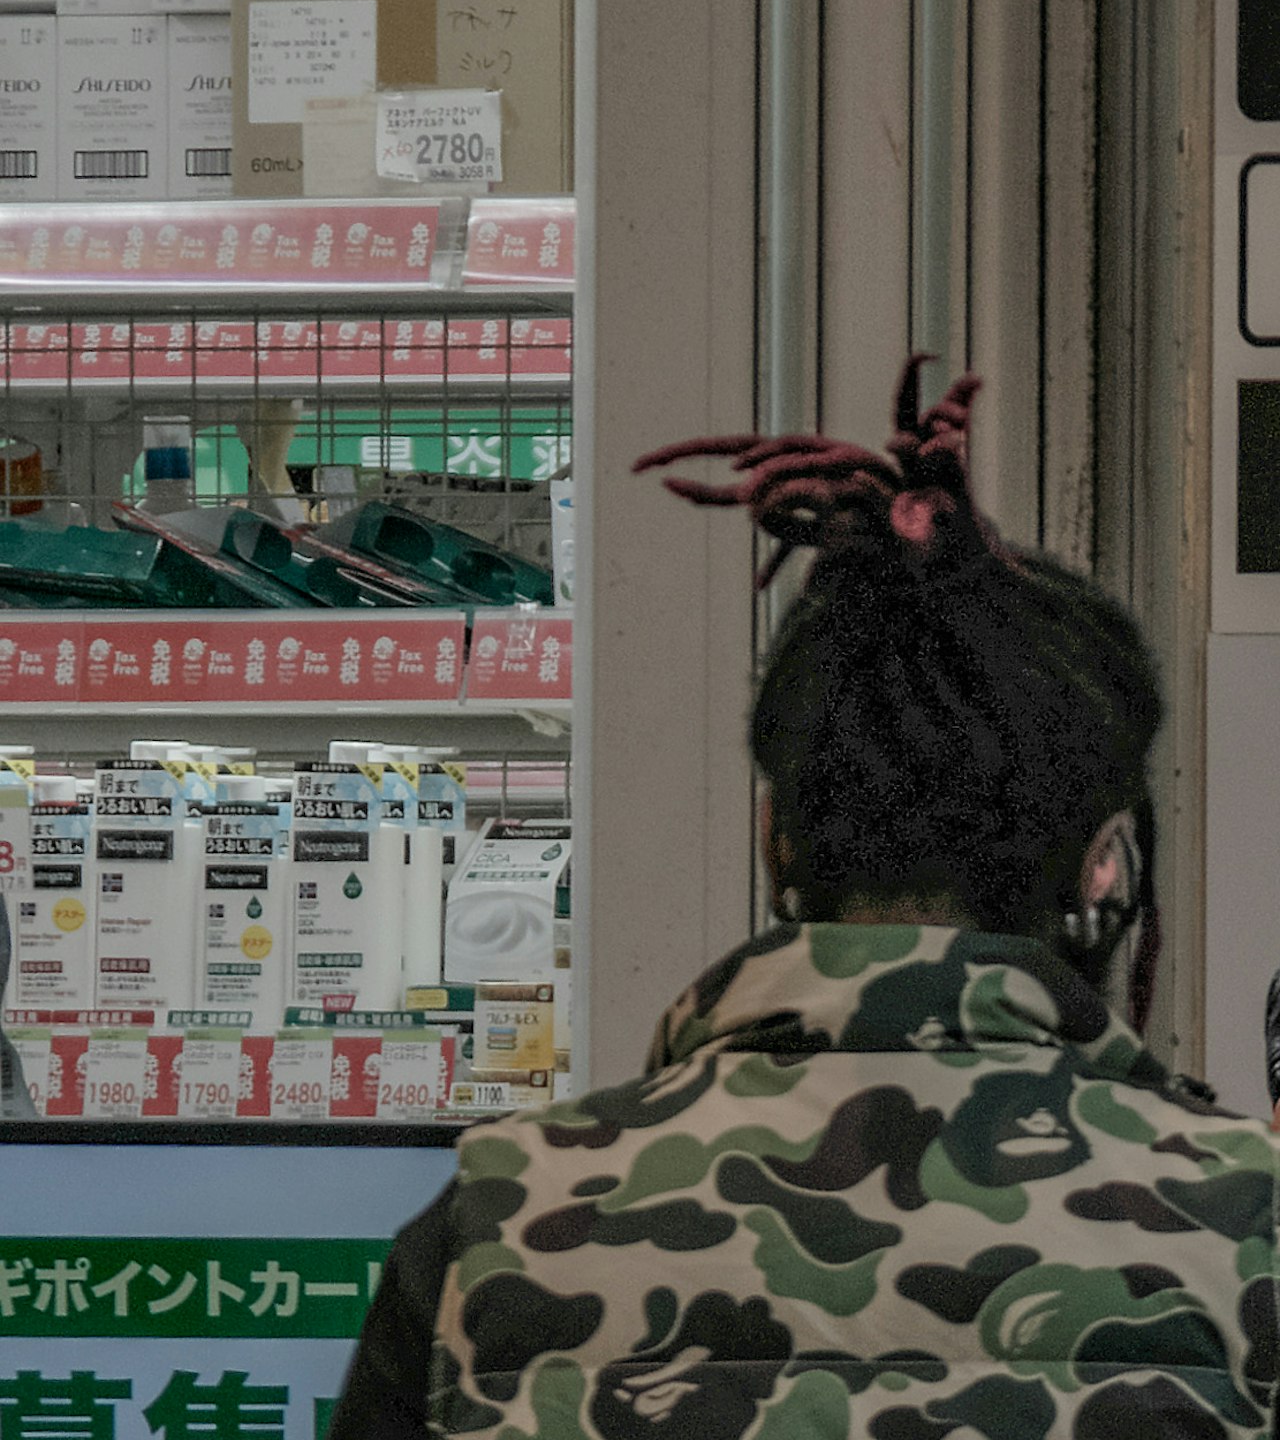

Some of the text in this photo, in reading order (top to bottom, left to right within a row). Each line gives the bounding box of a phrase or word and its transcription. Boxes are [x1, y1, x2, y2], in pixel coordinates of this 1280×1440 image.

[73, 77, 151, 93] SHISEIDO
[20, 651, 42, 662] Tax
[114, 651, 136, 662] Tax
[209, 651, 232, 662] Tax
[304, 650, 326, 661] Tax
[399, 650, 421, 661] Tax
[298, 776, 336, 796] 朝まで
[207, 817, 243, 835] 朝まで
[325, 997, 353, 1008] NEW
[0, 1257, 382, 1319] ギポイントカー
